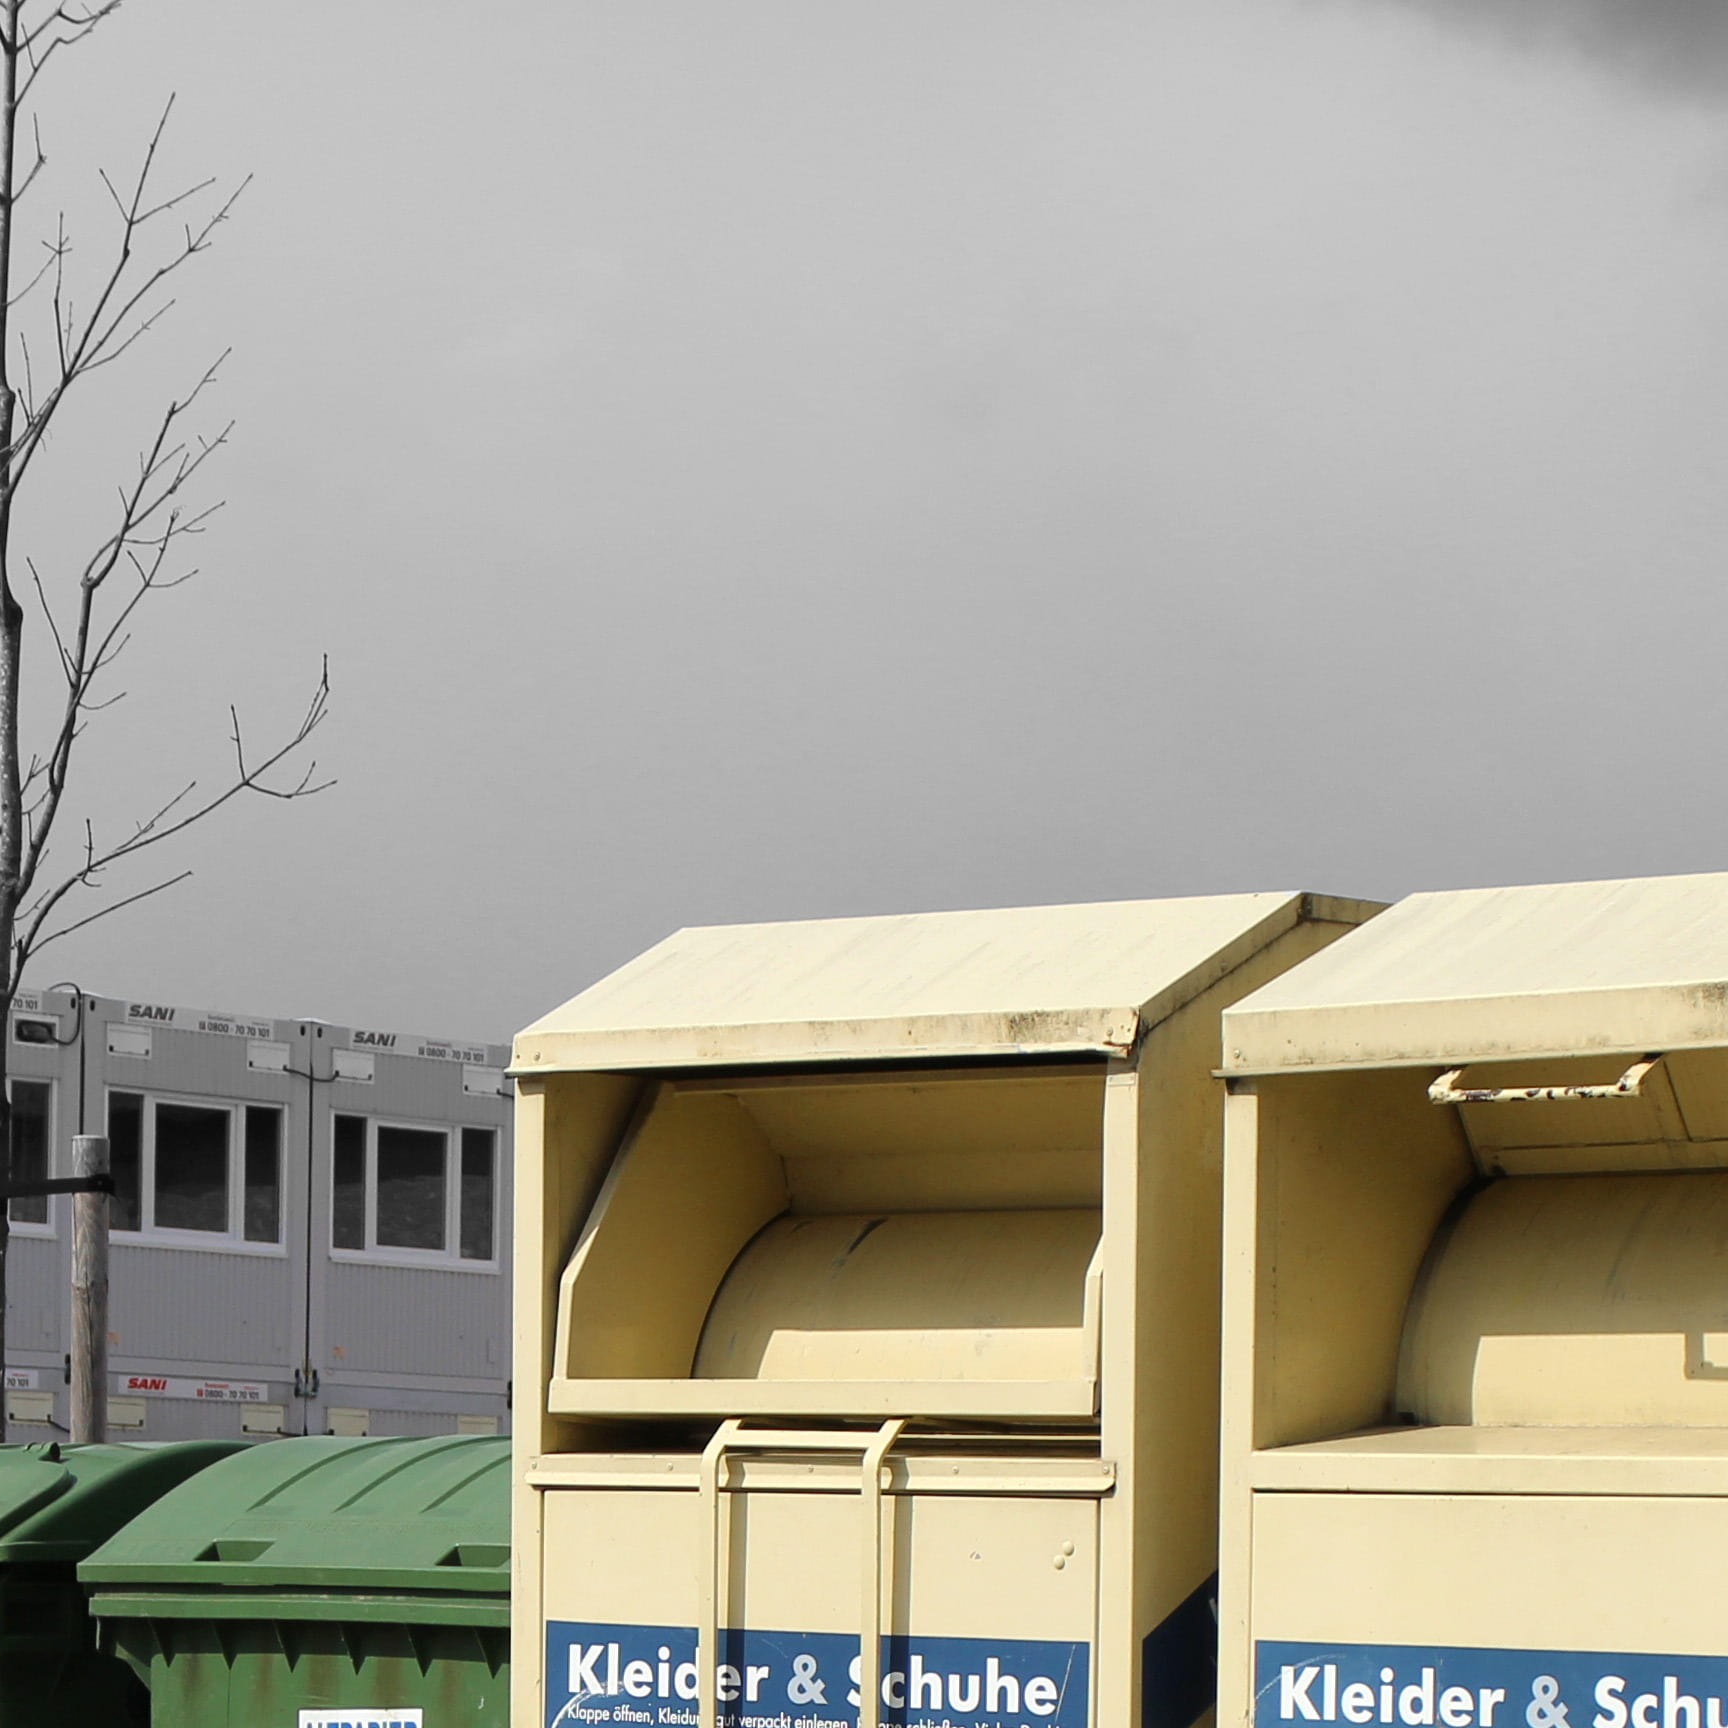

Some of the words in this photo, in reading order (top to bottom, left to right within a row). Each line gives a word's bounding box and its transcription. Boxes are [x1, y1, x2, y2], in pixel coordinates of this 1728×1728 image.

[25, 1000, 38, 1010] 101
[128, 1004, 175, 1021] SANI
[208, 1022, 229, 1033] 0800
[235, 1024, 245, 1035] 70
[247, 1025, 256, 1036] 70
[258, 1028, 270, 1037] 101
[353, 1031, 396, 1047] SANI
[427, 1048, 446, 1058] 0800
[452, 1050, 461, 1060] 70
[463, 1051, 471, 1061] 70
[473, 1053, 484, 1062] 101
[17, 1378, 29, 1387] 101
[128, 1378, 167, 1390] SANI
[205, 1389, 224, 1398] 0800
[229, 1390, 238, 1399] 70
[239, 1390, 247, 1400] 70
[568, 1643, 770, 1702] Kleider
[786, 1654, 829, 1705] &
[1280, 1664, 1505, 1727] Kleider
[567, 1702, 610, 1725] Klappe
[613, 1706, 654, 1726] öffnen,
